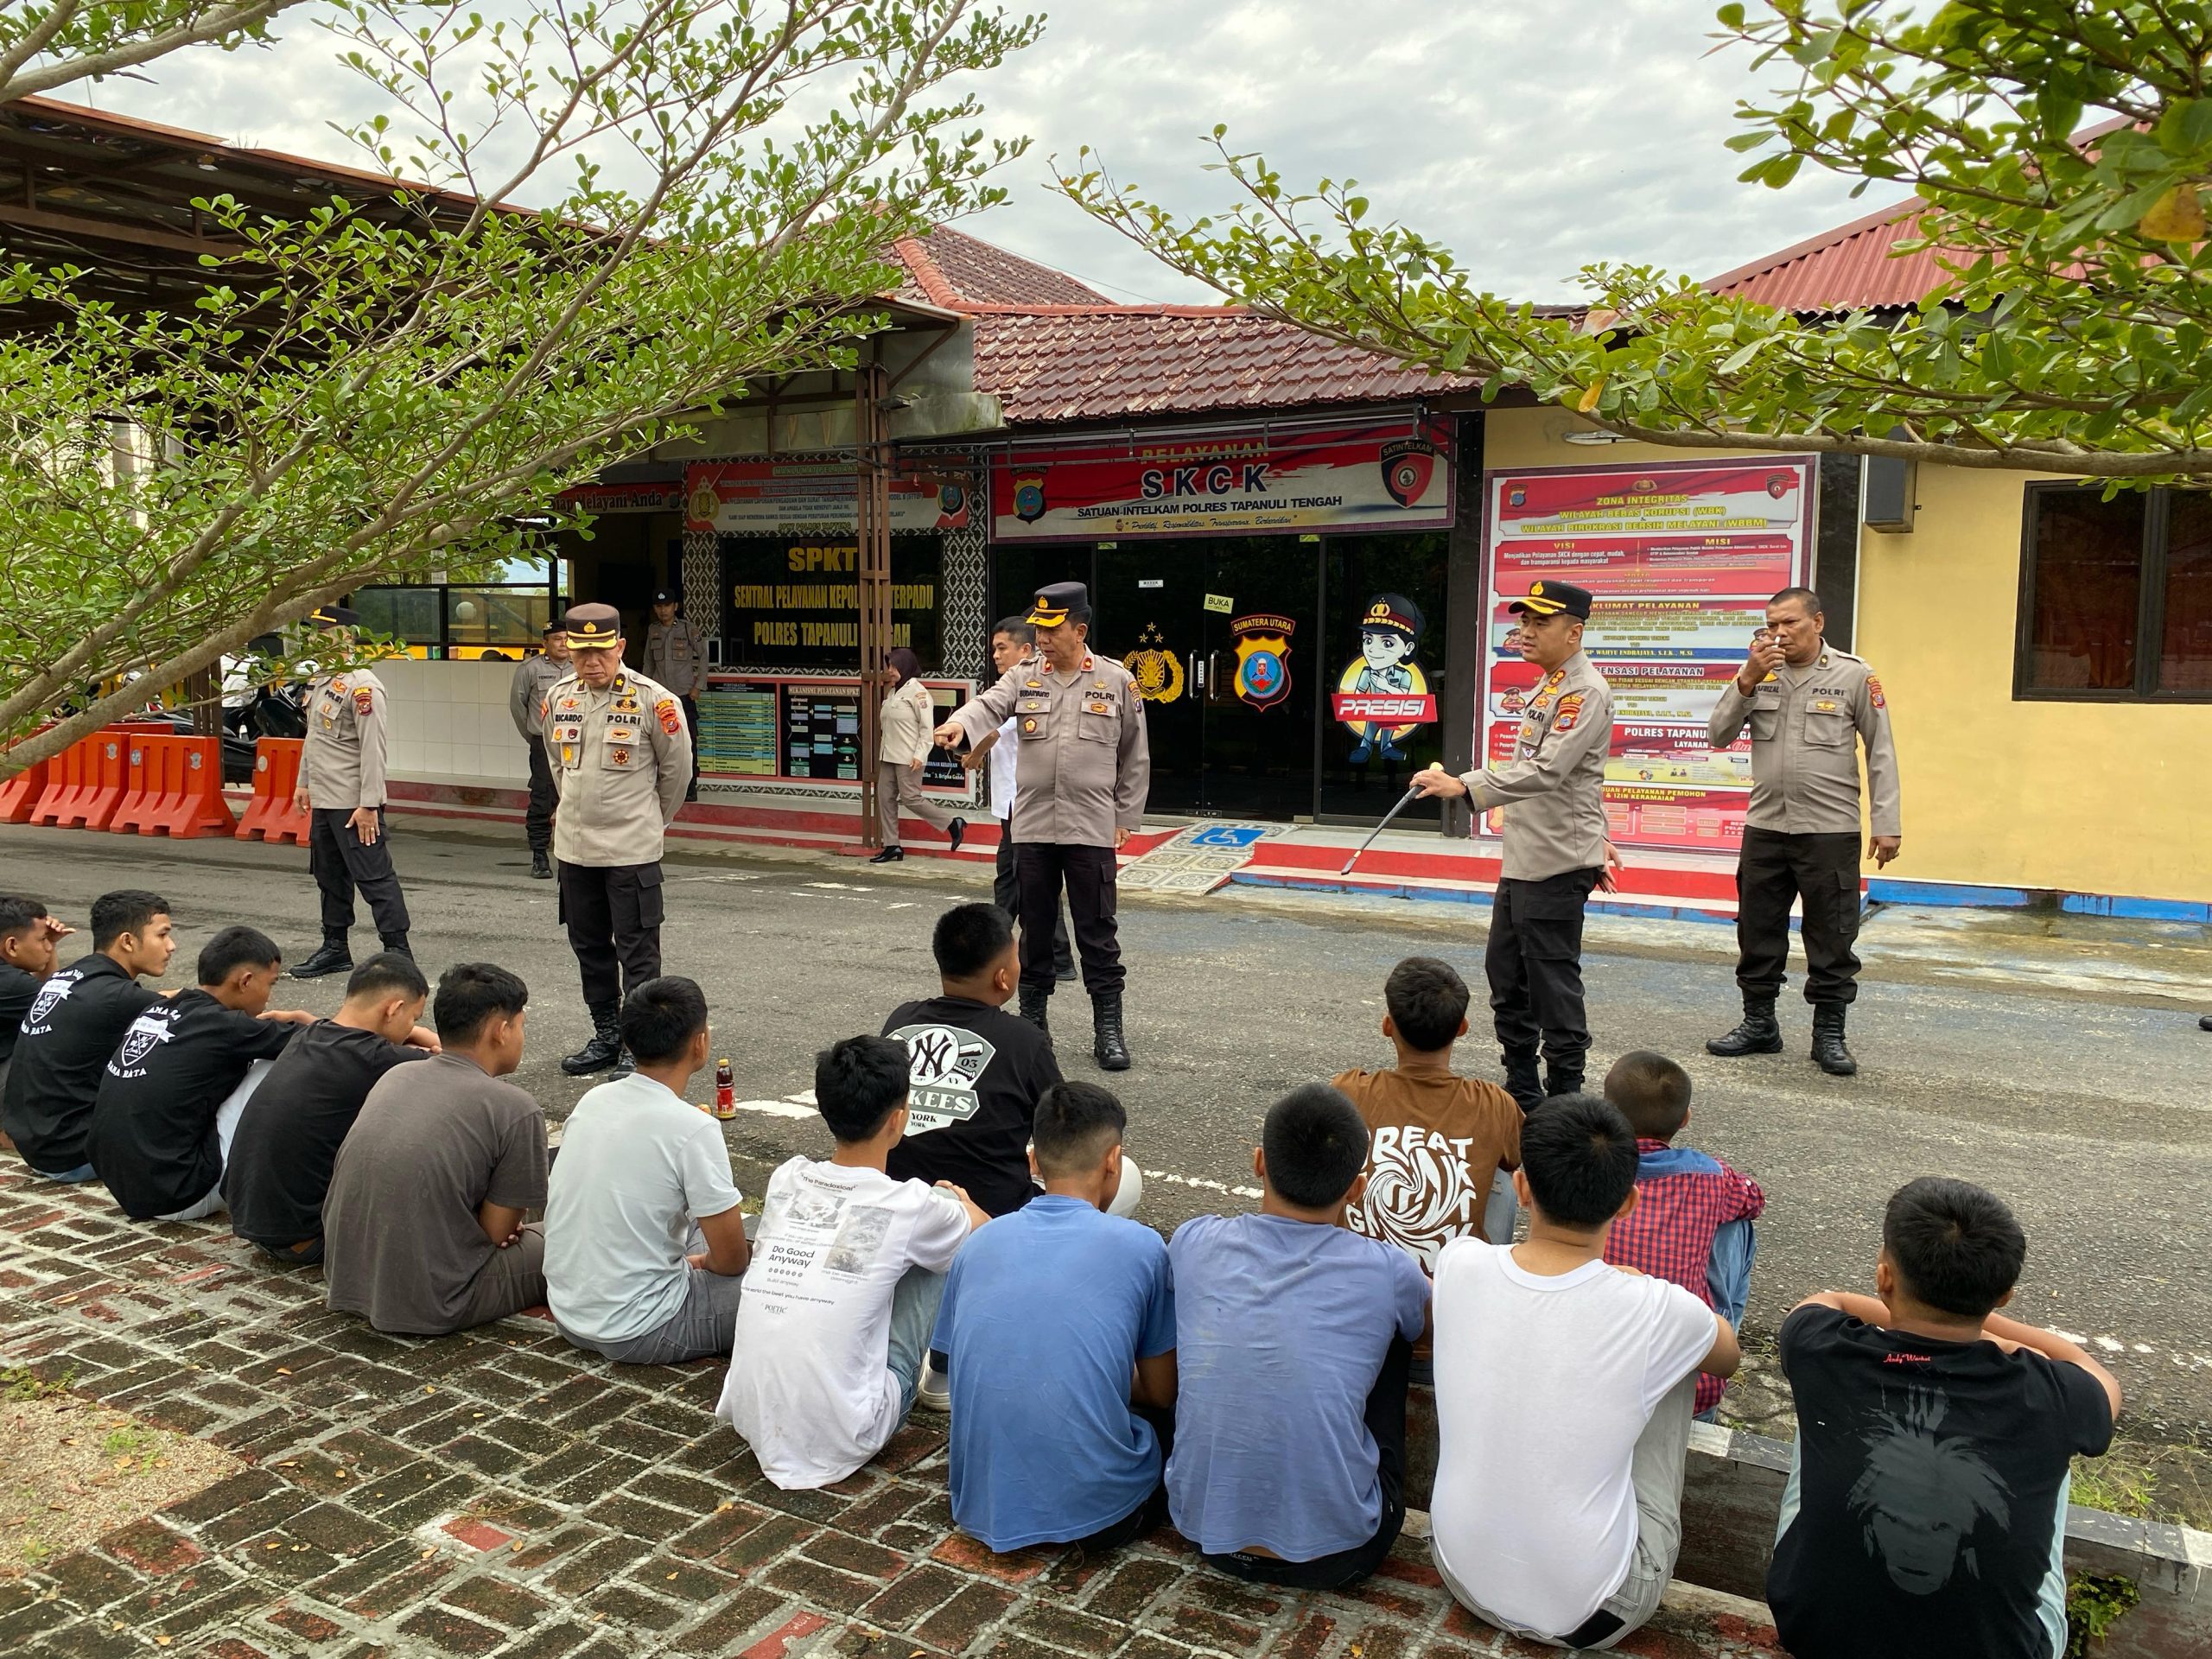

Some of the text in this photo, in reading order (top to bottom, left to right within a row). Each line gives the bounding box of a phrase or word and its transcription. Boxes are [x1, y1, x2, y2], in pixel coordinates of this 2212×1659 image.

[1141, 463, 1270, 500] SKCK
[632, 490, 662, 506] Anda
[1597, 494, 1688, 505] ZONA INTEGRITAS
[1077, 496, 1342, 518] SATUAN INTELKAM POLRES TAPANULI TENGAH
[1607, 509, 1641, 518] BEBAS
[1643, 507, 1689, 516] KORUPSI
[1693, 506, 1726, 516] (WBK)
[1521, 518, 1768, 533] WILAYAH BIROKRASI BERSIH MELAYANI (WBBM)
[788, 547, 858, 572] SPKT
[1561, 557, 1580, 566] kepada
[734, 585, 773, 608] SENTRAL
[776, 585, 828, 608] PELAYANAN
[890, 585, 934, 609] TERPADU
[1208, 596, 1230, 607] BUKA
[1234, 619, 1292, 632] SUMATERA UTARA
[754, 622, 798, 645] POLRES
[801, 622, 858, 646] TAPANULI
[1595, 666, 1705, 677] PENSASI PELAYANAN
[325, 690, 343, 704] POLRI
[1085, 691, 1115, 702] POLRI
[1812, 688, 1845, 696] POLRI
[1338, 699, 1427, 716] PRESISI
[555, 714, 583, 723] RICARDO
[607, 715, 641, 725] POLRI
[1527, 709, 1545, 723] POLRI
[1624, 728, 1708, 740] POLRES TAPANU
[1675, 741, 1709, 749] LAYANAN
[961, 1058, 978, 1068] 03
[122, 1067, 147, 1078] RATA
[908, 1090, 973, 1113] KEES
[911, 1112, 937, 1122] YORK
[1363, 1125, 1473, 1168] REAT
[786, 1248, 816, 1259] Good
[768, 1254, 811, 1268] Anyway
